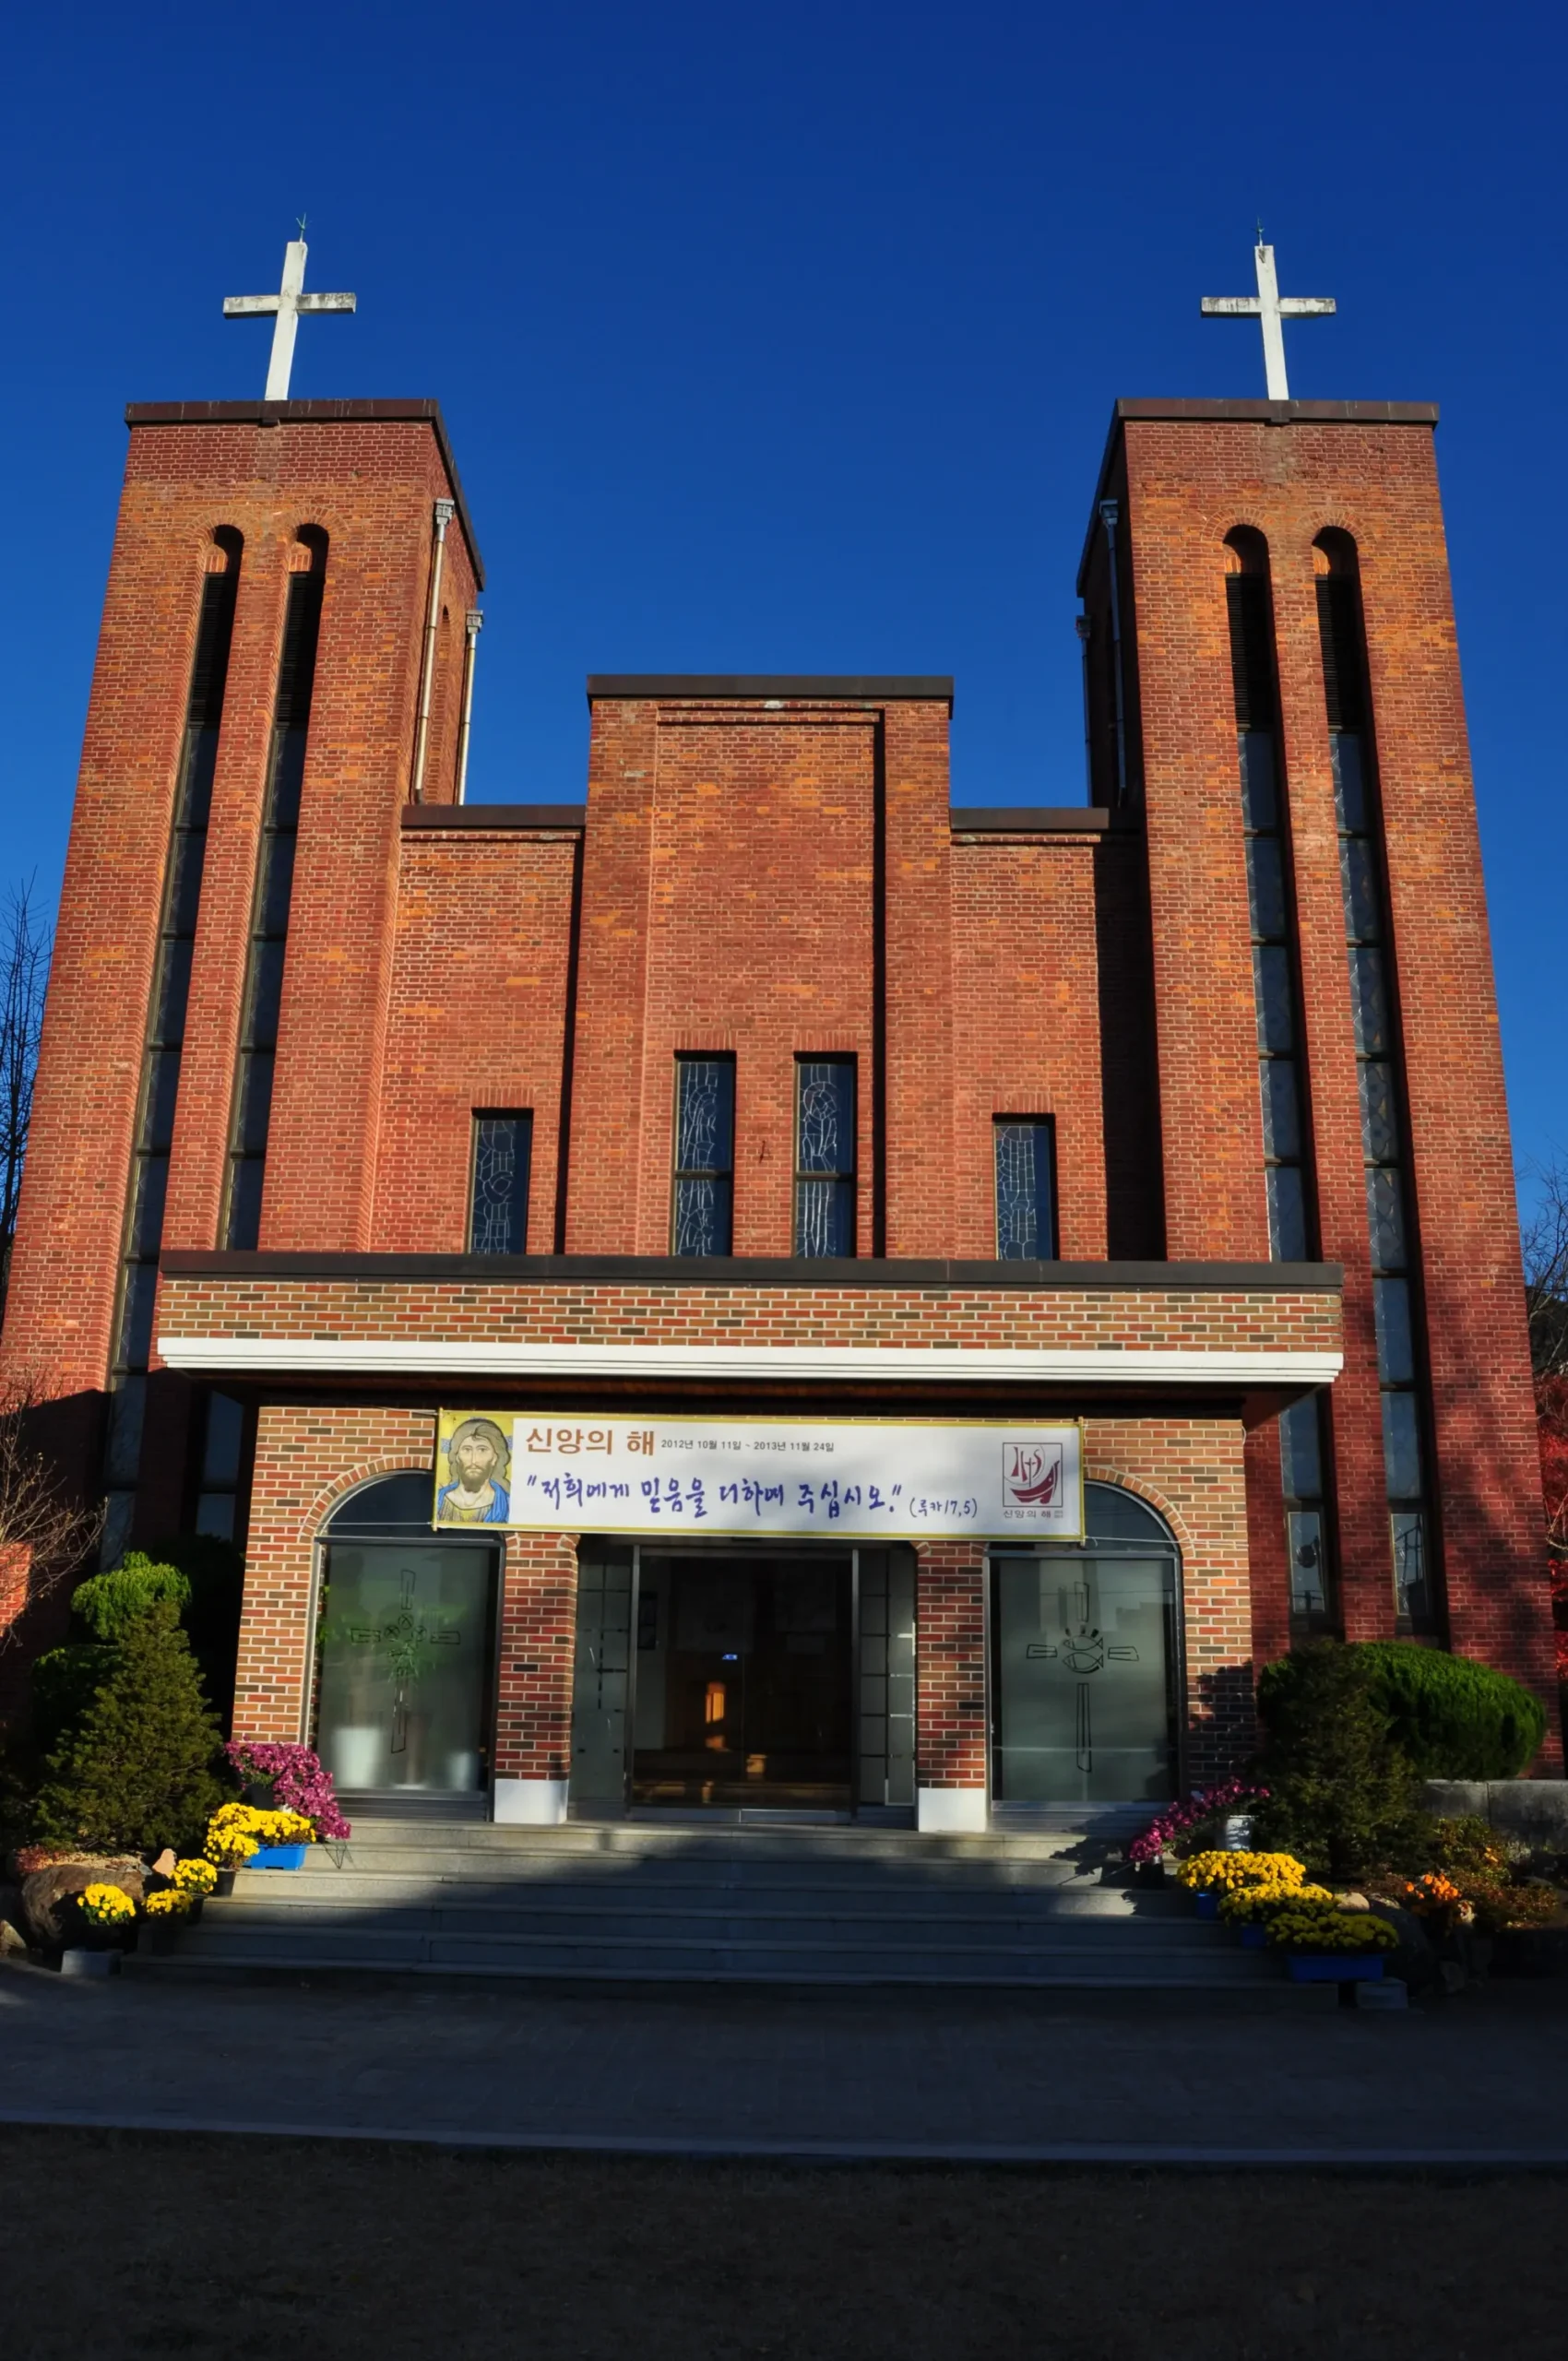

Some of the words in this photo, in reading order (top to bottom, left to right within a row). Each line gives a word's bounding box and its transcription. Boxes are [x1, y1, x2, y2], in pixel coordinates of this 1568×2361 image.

[526, 1428, 613, 1455] 신앙의
[626, 1430, 654, 1456] 해
[660, 1439, 694, 1450] 2012년
[697, 1440, 718, 1450] 10월
[721, 1441, 742, 1451] 11일
[754, 1441, 786, 1452] 2013년
[790, 1442, 810, 1452] 11월
[814, 1442, 835, 1453] 24일
[641, 1477, 707, 1518] 믿음을
[719, 1477, 784, 1516] 더하여
[1003, 1510, 1037, 1519] 신앙의
[1040, 1510, 1051, 1519] 해
